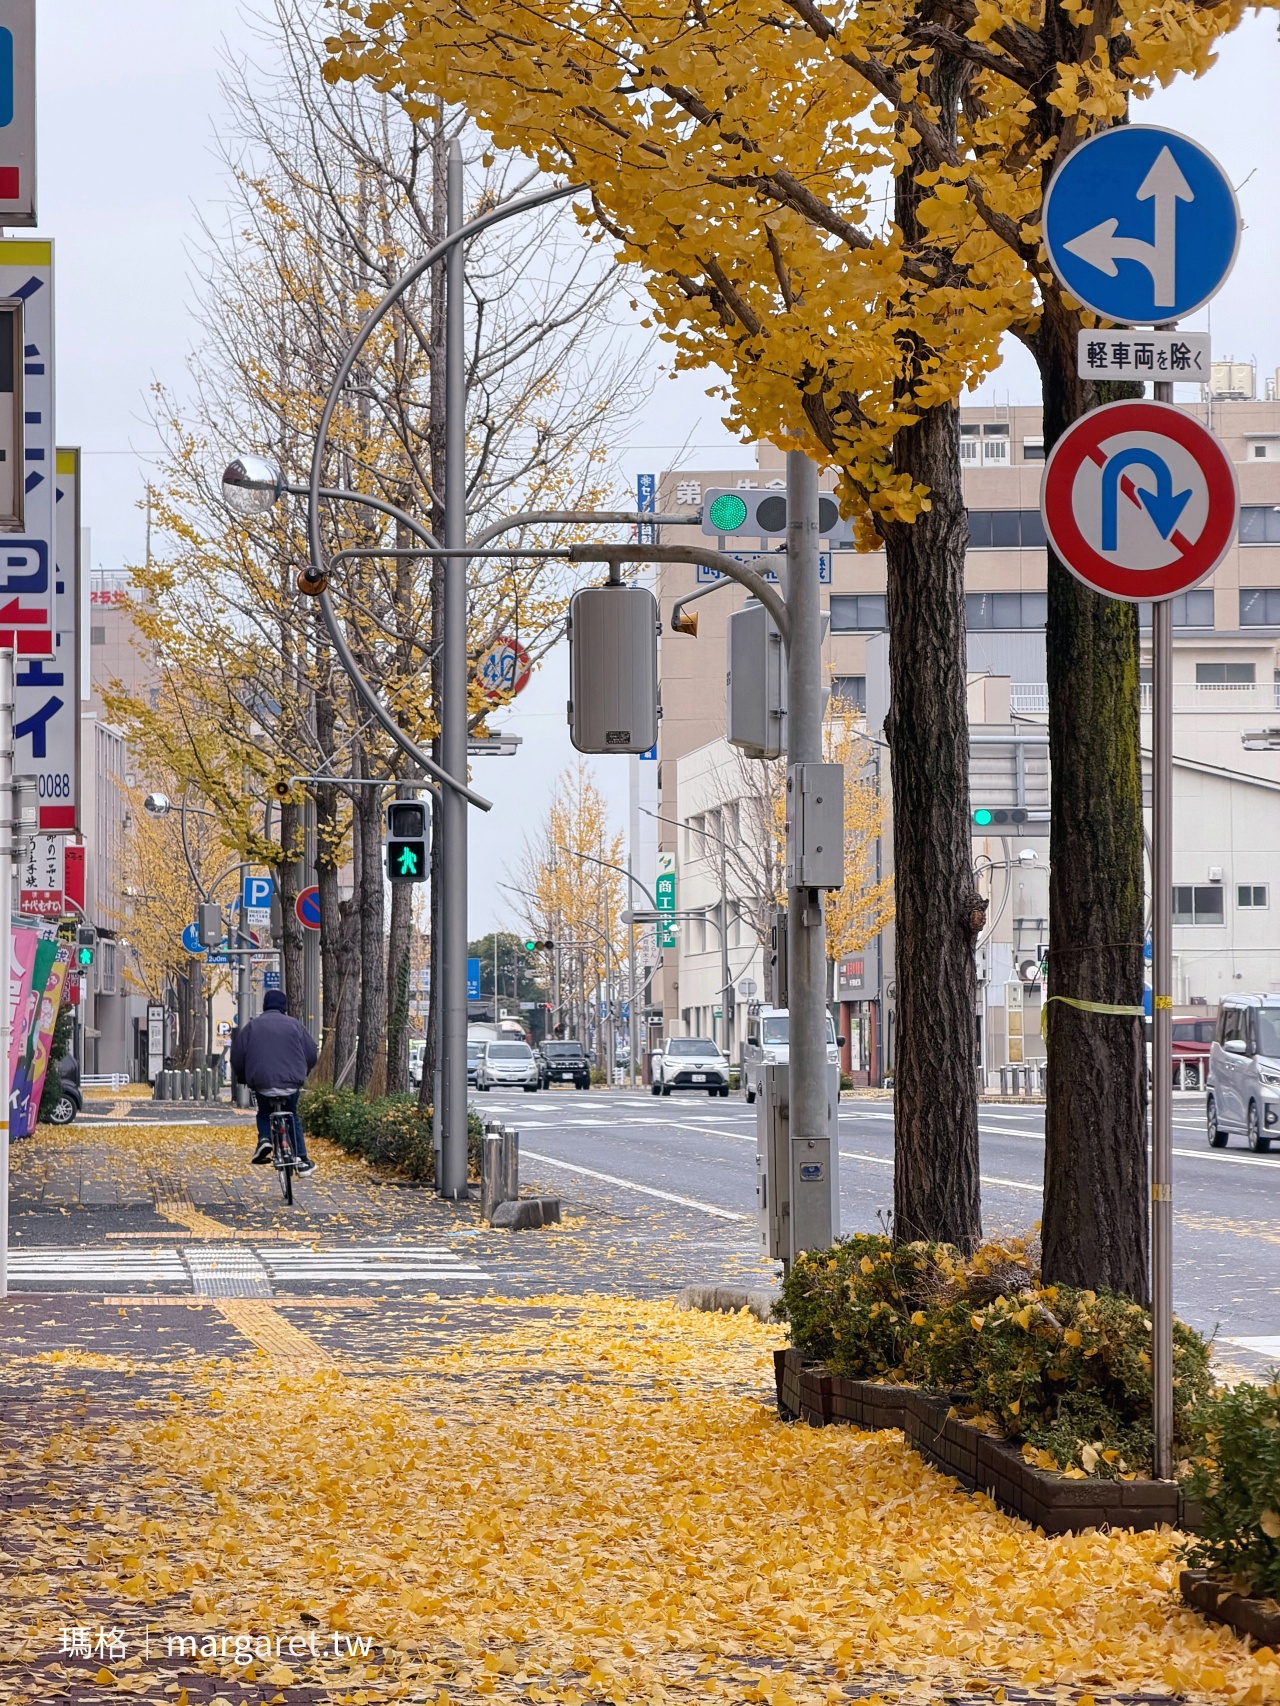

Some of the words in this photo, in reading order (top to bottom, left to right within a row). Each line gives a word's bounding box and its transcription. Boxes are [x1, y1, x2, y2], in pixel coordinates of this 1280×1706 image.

[1087, 341, 1203, 370] 軽車両を除く
[38, 773, 70, 798] 0088
[252, 880, 270, 905] P
